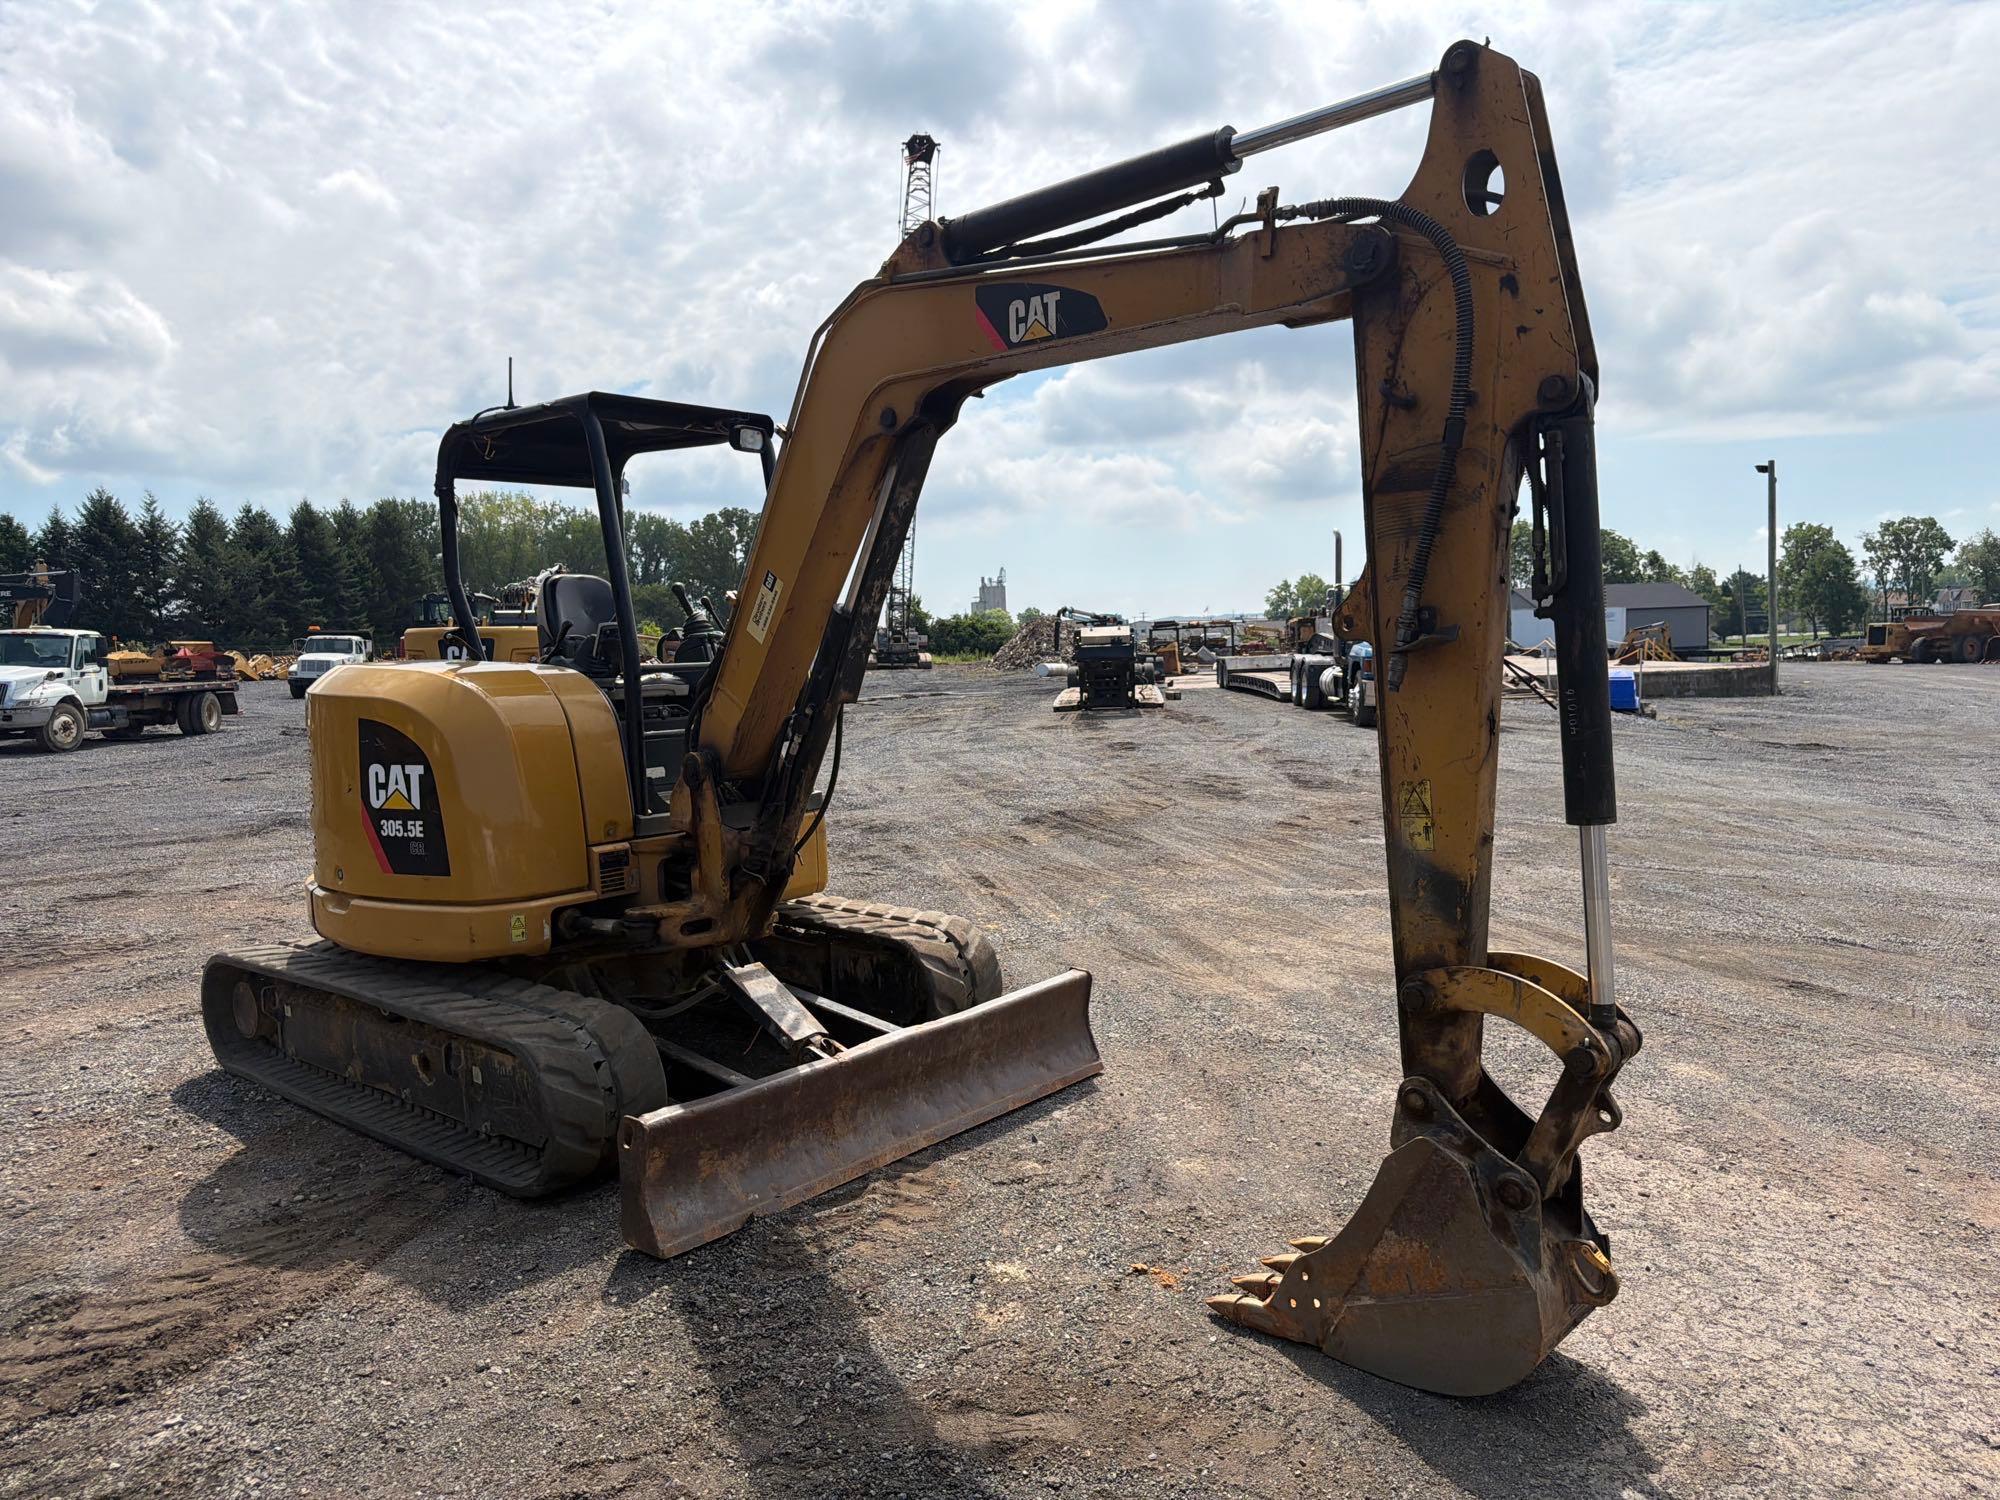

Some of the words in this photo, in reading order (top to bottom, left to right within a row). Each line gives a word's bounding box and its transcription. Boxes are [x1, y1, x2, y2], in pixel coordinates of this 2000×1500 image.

[1009, 290, 1061, 343] CAT
[765, 572, 775, 589] CAT
[368, 763, 424, 810] CAT
[380, 819, 424, 838] 305.5E
